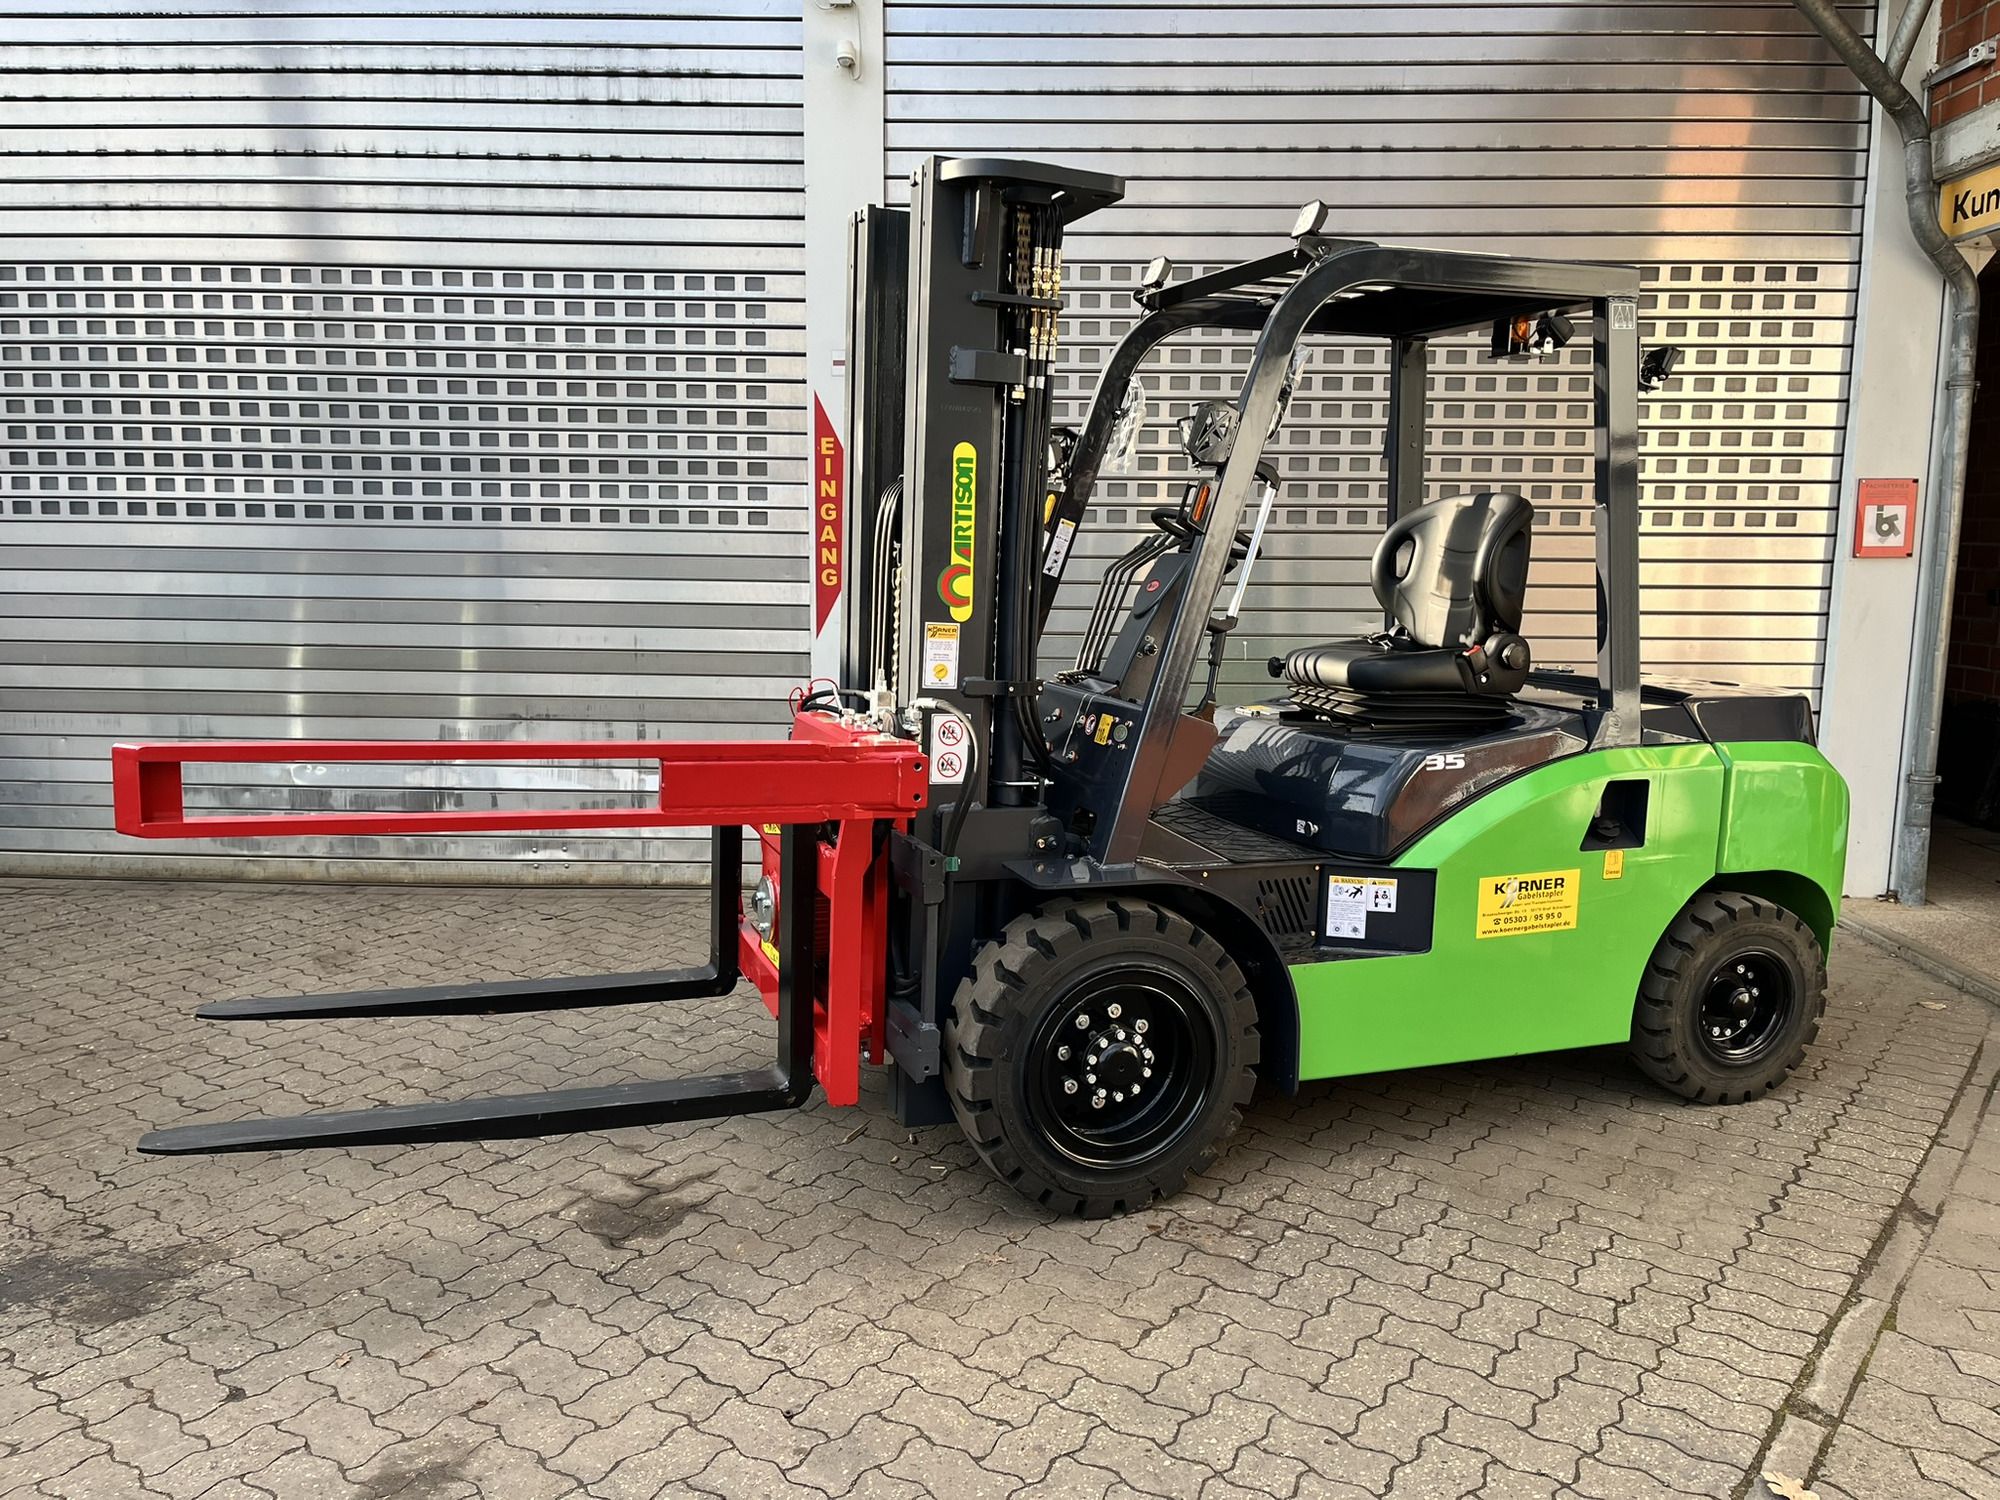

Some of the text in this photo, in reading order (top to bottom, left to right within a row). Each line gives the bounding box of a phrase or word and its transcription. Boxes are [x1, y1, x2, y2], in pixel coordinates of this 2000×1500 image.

[1952, 188, 2000, 224] Kun
[820, 437, 838, 586] EINGANG
[1426, 754, 1465, 771] 35
[1494, 877, 1565, 895] KÖRNER
[1517, 890, 1564, 901] Gabelstapler
[1503, 915, 1528, 925] 05303
[1533, 913, 1544, 921] 95
[1545, 911, 1556, 920] 95
[1556, 911, 1563, 919] 0
[1482, 921, 1570, 934] www.koernergabelstapler.de
